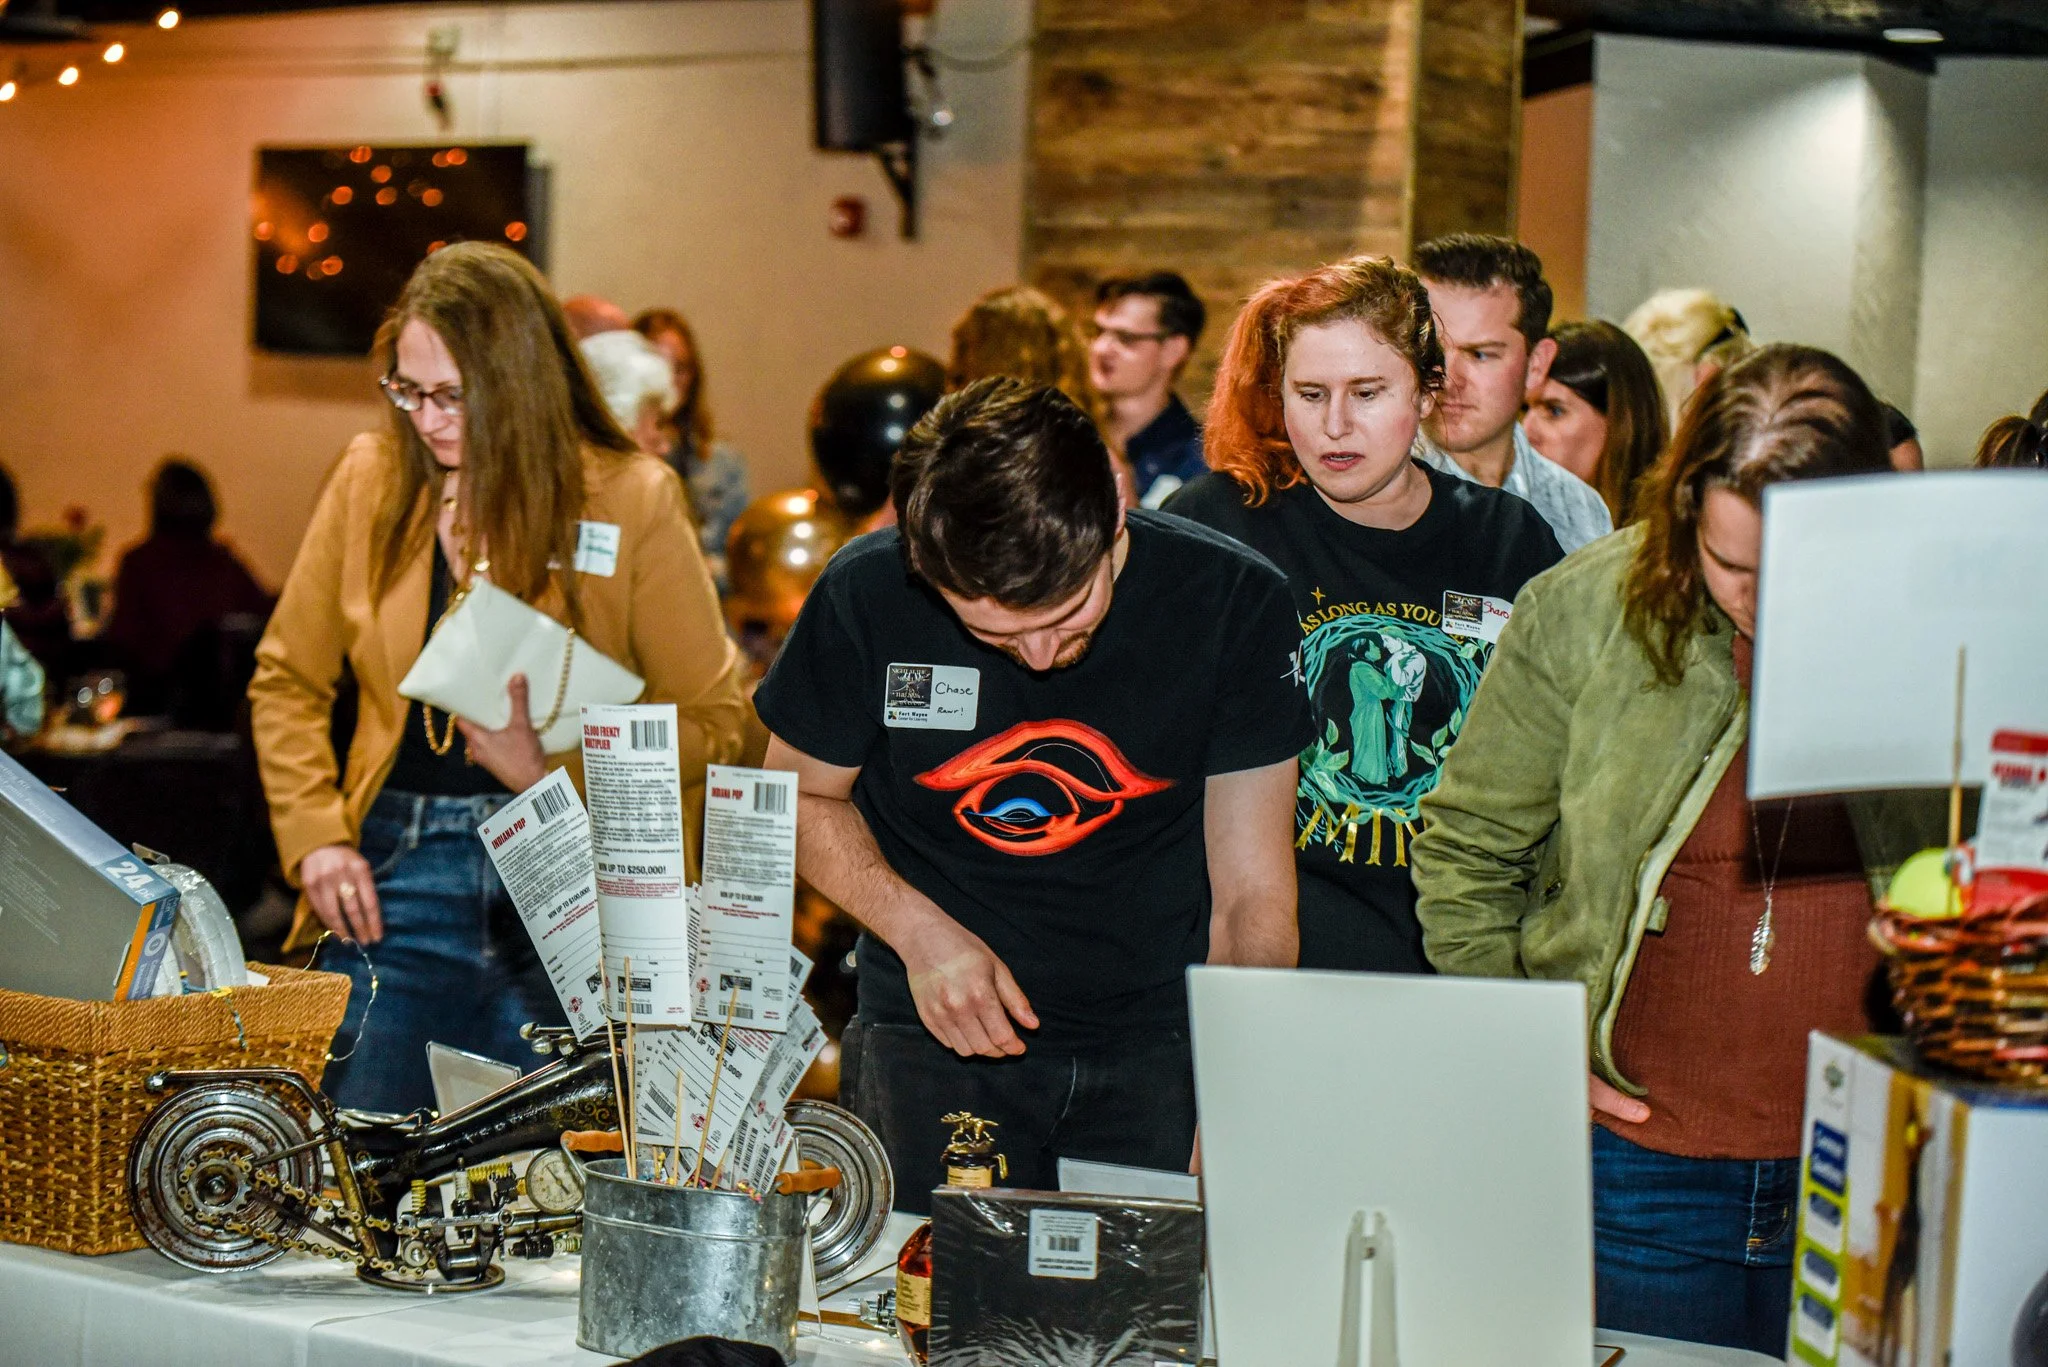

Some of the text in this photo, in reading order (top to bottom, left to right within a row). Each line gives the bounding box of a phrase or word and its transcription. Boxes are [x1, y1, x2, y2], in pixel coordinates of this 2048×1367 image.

[1300, 614, 1321, 636] AS
[1316, 601, 1371, 622] LONG
[1374, 602, 1397, 616] AS
[935, 682, 973, 695] Chase
[491, 817, 526, 850] INDIANA POP
[105, 861, 154, 889] 24
[608, 864, 616, 872] UP
[617, 865, 626, 873] TO
[628, 865, 666, 875] $250,000!
[556, 905, 563, 913] UP
[562, 900, 570, 908] TO
[697, 1036, 706, 1045] UP
[706, 1044, 715, 1056] TO
[716, 1054, 742, 1079] $5,000!
